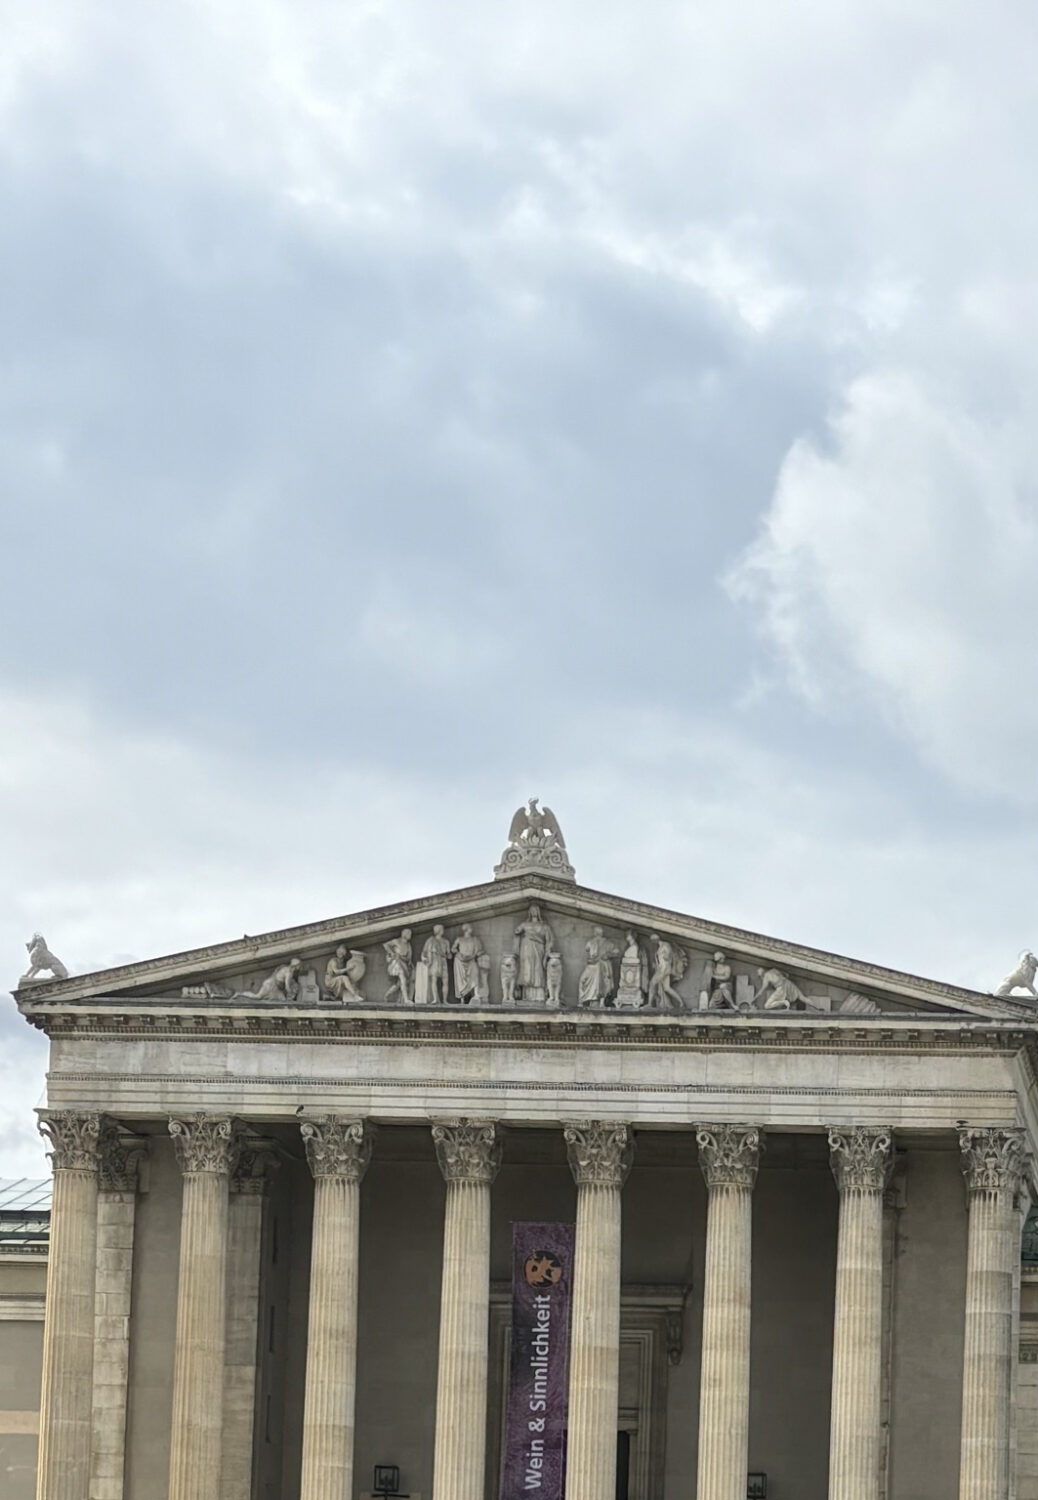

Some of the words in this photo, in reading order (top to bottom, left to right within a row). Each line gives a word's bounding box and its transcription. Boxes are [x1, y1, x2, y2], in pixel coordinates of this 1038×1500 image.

[530, 1294, 551, 1412] Sinnlichkeit
[528, 1416, 546, 1433] &
[525, 1438, 545, 1491] Wein
